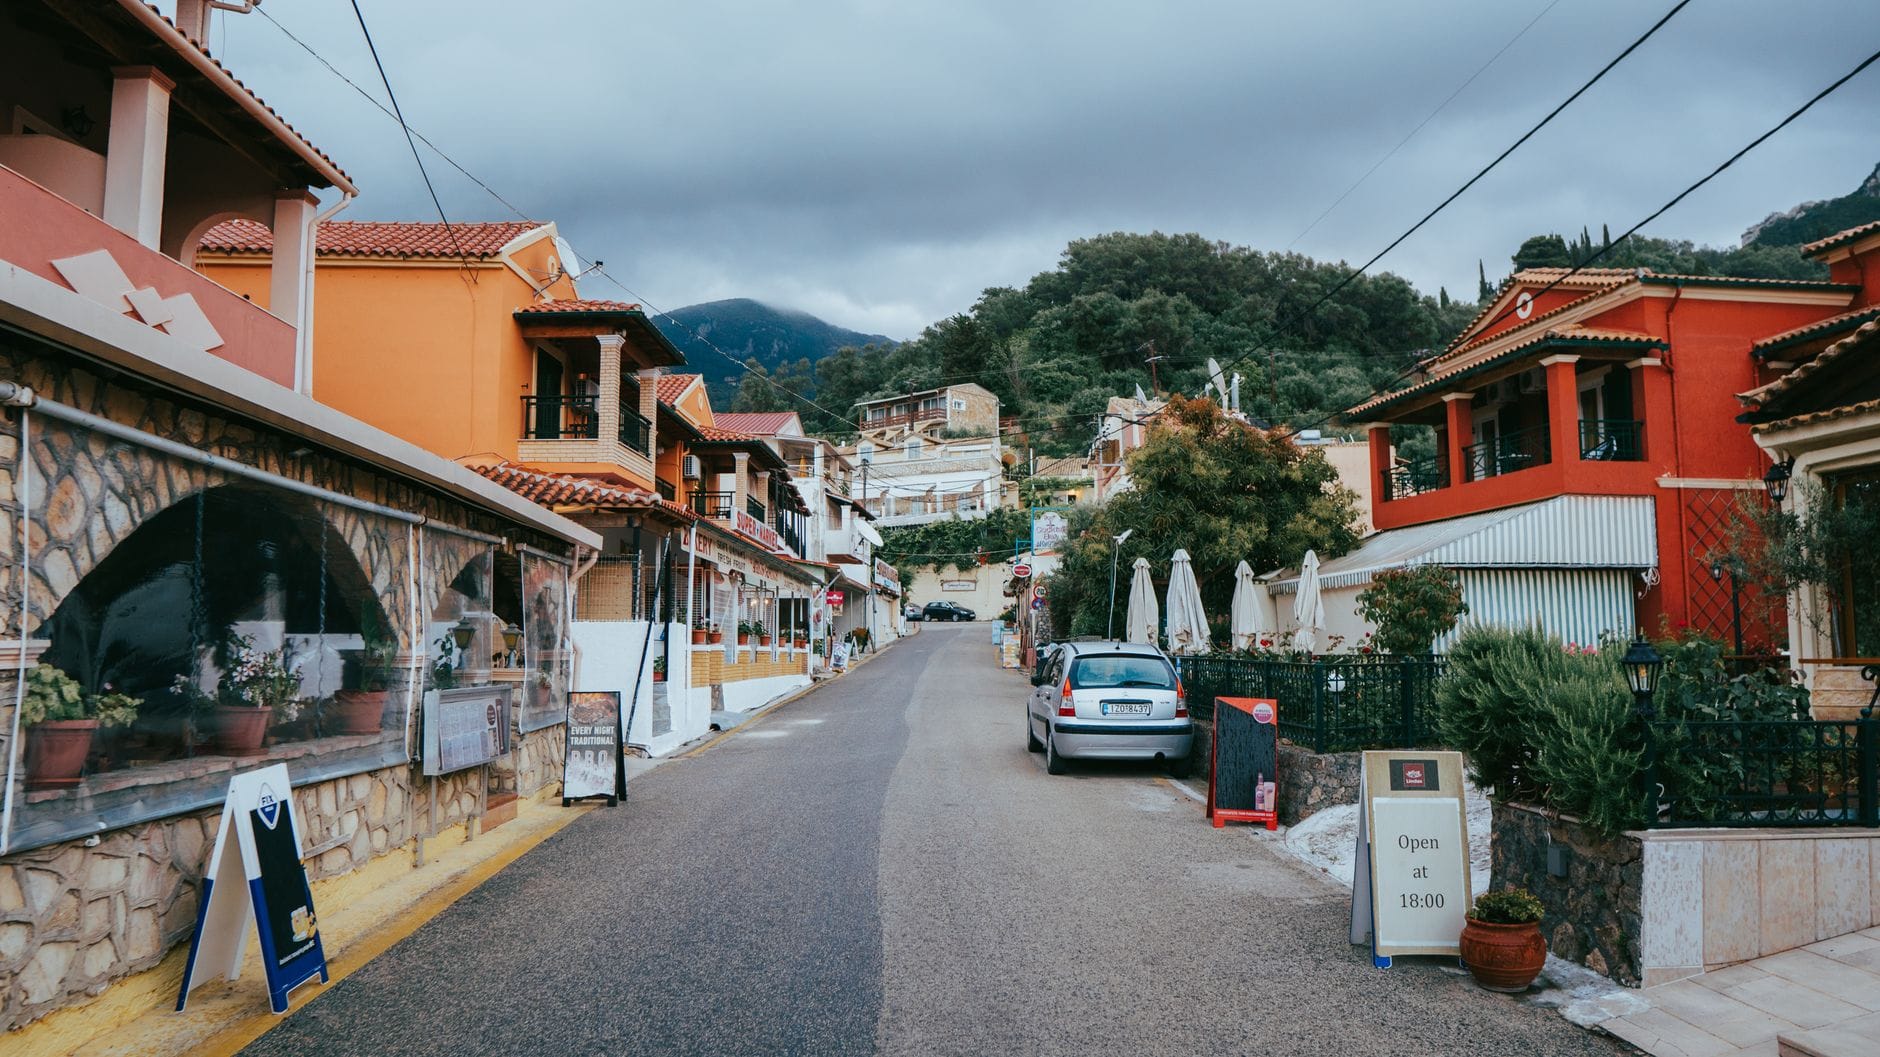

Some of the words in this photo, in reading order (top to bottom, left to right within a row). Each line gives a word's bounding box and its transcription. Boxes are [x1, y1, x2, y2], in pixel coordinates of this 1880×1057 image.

[737, 511, 757, 537] SUPER
[571, 726, 592, 735] EVERY
[593, 726, 615, 735] NIGHT
[571, 736, 614, 745] TRADITIONAL
[261, 794, 274, 805] FIX
[1398, 834, 1439, 853] Open
[1412, 865, 1429, 879] at
[1400, 893, 1445, 909] 18:00
